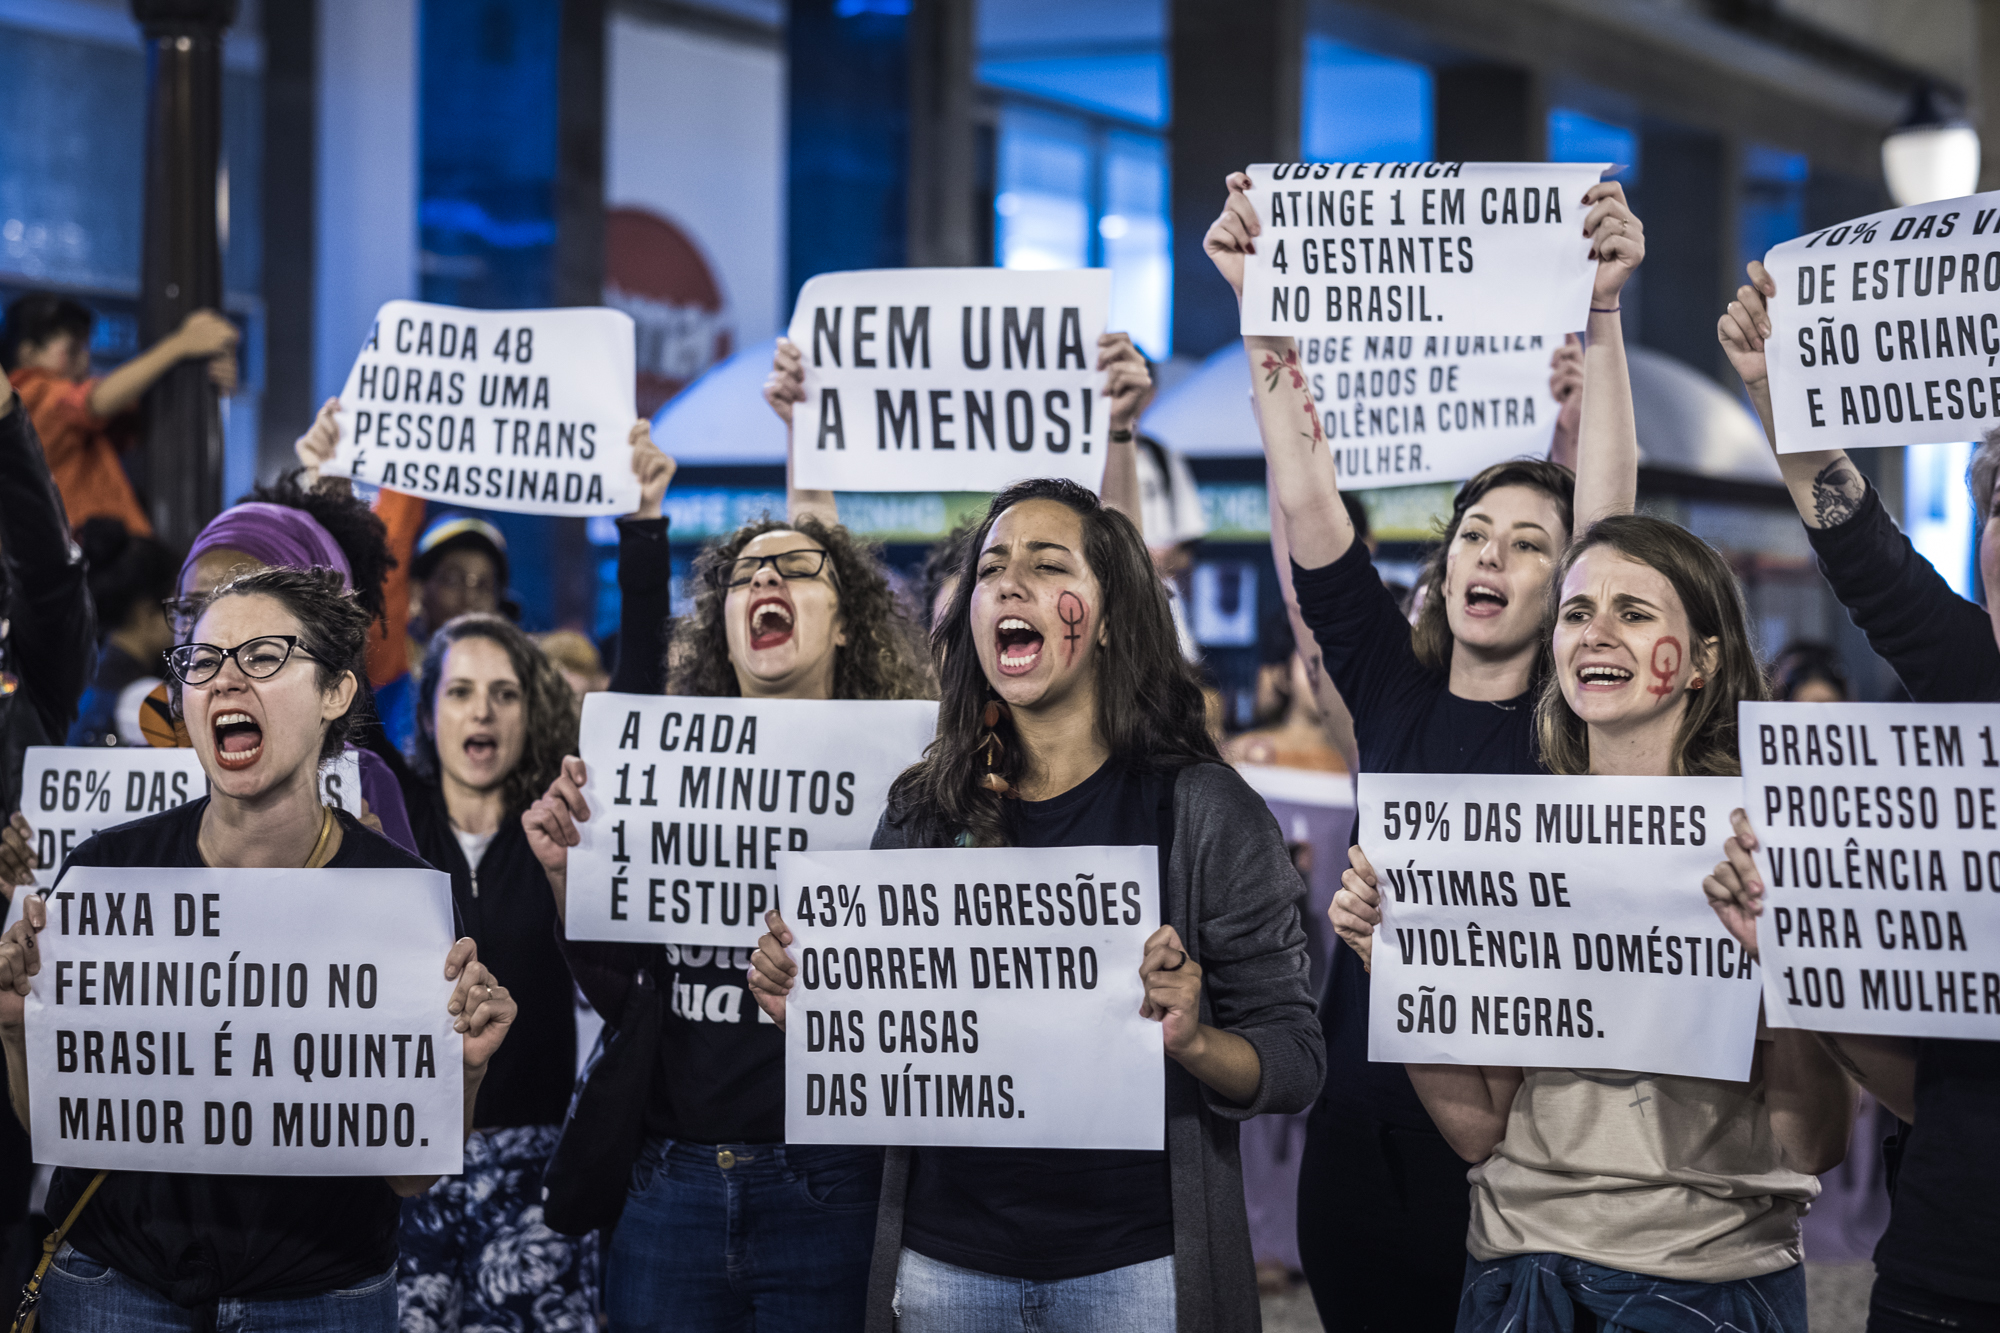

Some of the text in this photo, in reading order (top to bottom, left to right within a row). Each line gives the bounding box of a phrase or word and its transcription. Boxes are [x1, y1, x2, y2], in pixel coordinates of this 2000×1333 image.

[1271, 186, 1563, 227] ATINGE 1 EM CADA
[1805, 219, 1883, 248] 70%
[1889, 212, 1961, 242] DAS
[1272, 236, 1474, 275] 4 GESTANTES
[1797, 251, 2000, 306] DE ESTUPRO
[1271, 285, 1444, 323] NO BRASIL.
[396, 317, 478, 362] CADA
[493, 327, 533, 363] 48
[812, 305, 1086, 371] NEM UMA
[1798, 312, 2000, 368] SÃO CRIANÇ
[358, 364, 550, 410] HORAS UMA
[1310, 365, 1459, 402] S DADOS DE
[817, 386, 1093, 455] A MENOS!
[1318, 397, 1537, 440] OLÊNCIA CONTRA
[1806, 388, 1826, 428] E
[354, 411, 597, 460] PESSOA TRANS
[351, 450, 615, 505] É ASSASSINADA.
[619, 710, 757, 757] A CADA
[1759, 723, 2000, 768] BRASIL TEM 1
[40, 768, 111, 812] 66%
[125, 770, 189, 813] DAS
[613, 764, 856, 817] 11 MINUTOS
[1764, 785, 1998, 830] PROCESSO DE
[611, 819, 631, 863] 1
[1383, 800, 1707, 847] 59% DAS MULHERES
[1386, 858, 1572, 909] VÍTIMAS DE
[1767, 837, 1948, 892] VIOLÊNCIA
[55, 891, 221, 938] TAXA DE
[610, 865, 629, 921] É
[797, 872, 1142, 928] 43% DAS AGRESSÕES
[1396, 921, 1754, 981] VIOLÊNCIA DOMÉSTICA
[1774, 906, 1967, 952] PARA CADA
[55, 950, 378, 1010] FEMINICÍDIO NO
[801, 945, 1099, 992] OCORREM DENTRO
[1783, 966, 2000, 1015] 100 MULHER
[671, 972, 744, 1024] tua
[1396, 985, 1605, 1040] SÃO NEGRAS.
[56, 1021, 437, 1083] BRASIL É A QUINTA
[806, 1009, 865, 1054] DAS
[878, 1008, 979, 1054] CASAS
[806, 1062, 1026, 1119] DAS VÍTIMAS.
[58, 1096, 430, 1149] MAIOR DO MUNDO.
